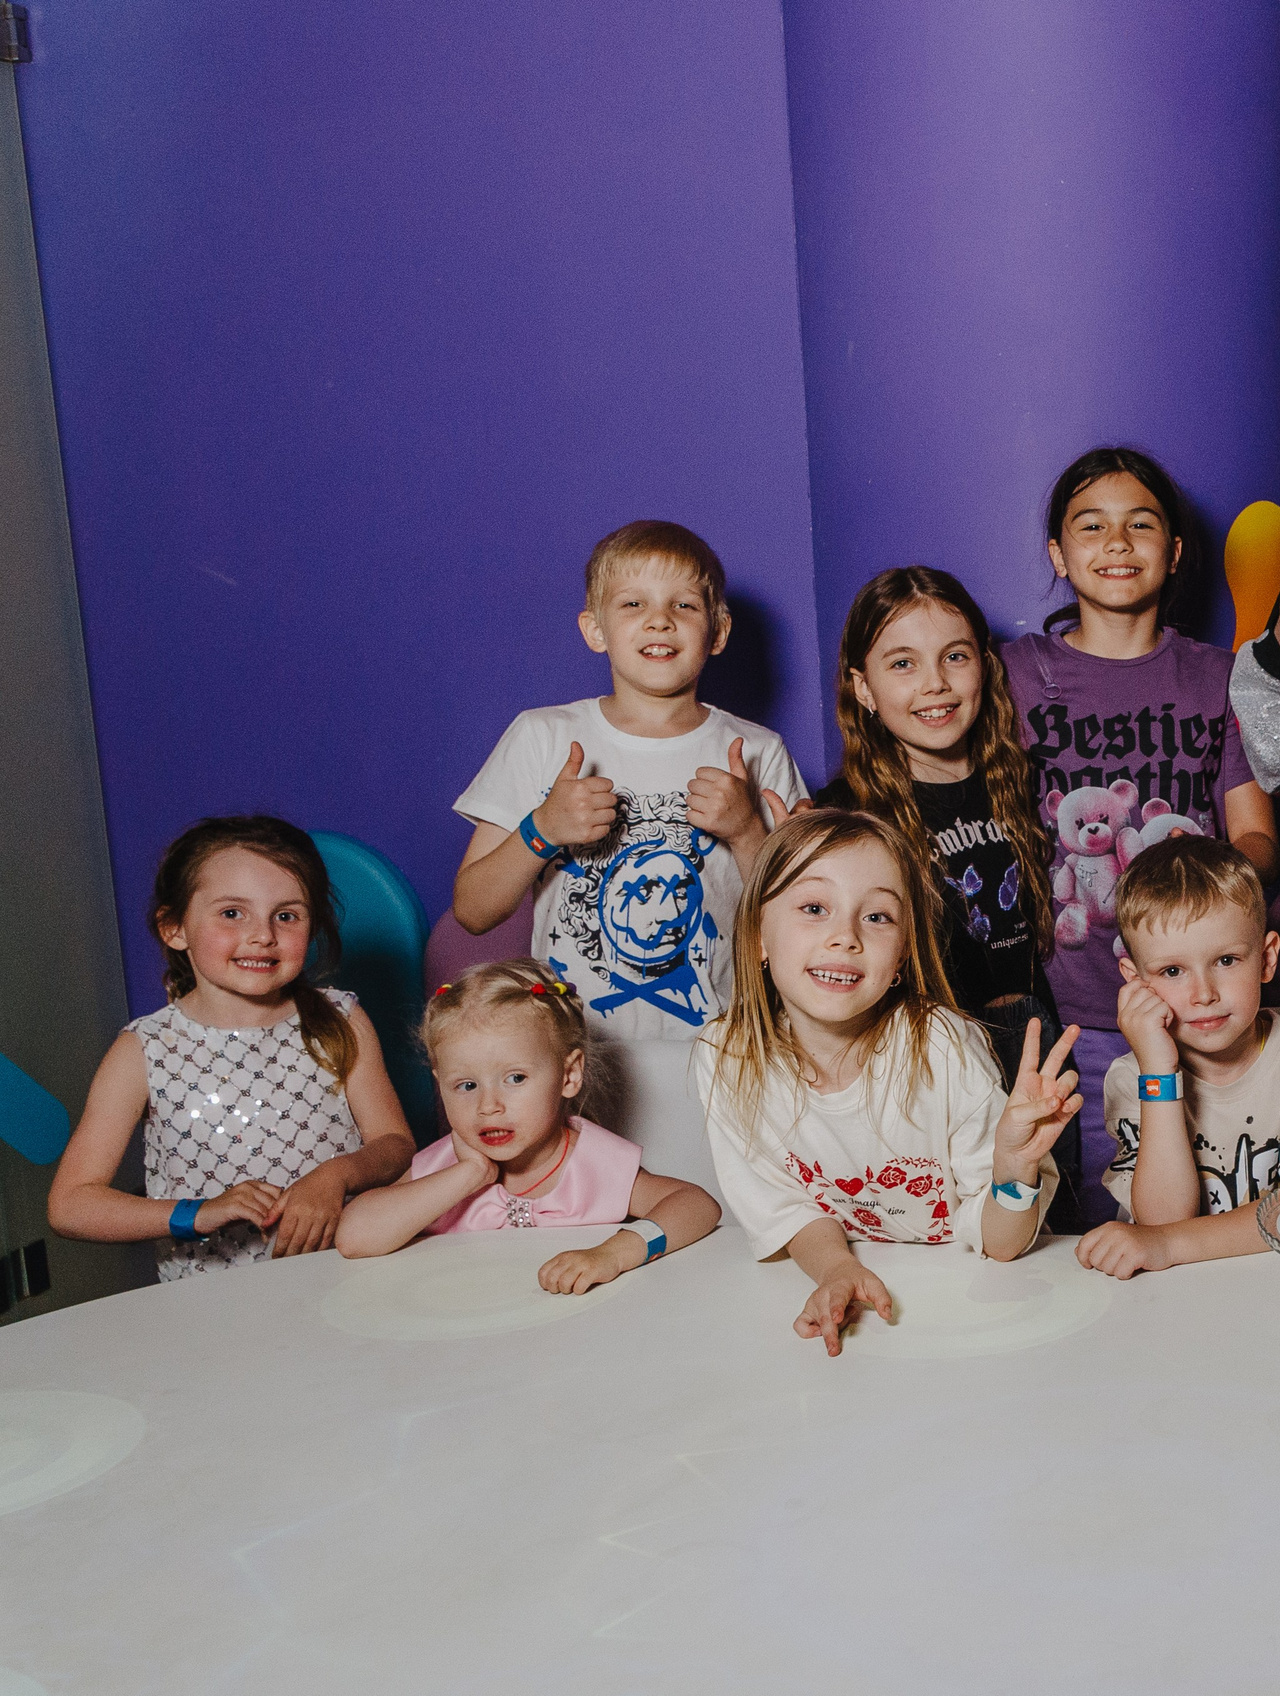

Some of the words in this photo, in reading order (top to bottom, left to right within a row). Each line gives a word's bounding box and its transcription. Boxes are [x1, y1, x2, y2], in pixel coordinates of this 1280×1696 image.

[1027, 703, 1222, 760] Besties
[1031, 757, 1217, 816] othe
[924, 817, 1010, 861] mbra
